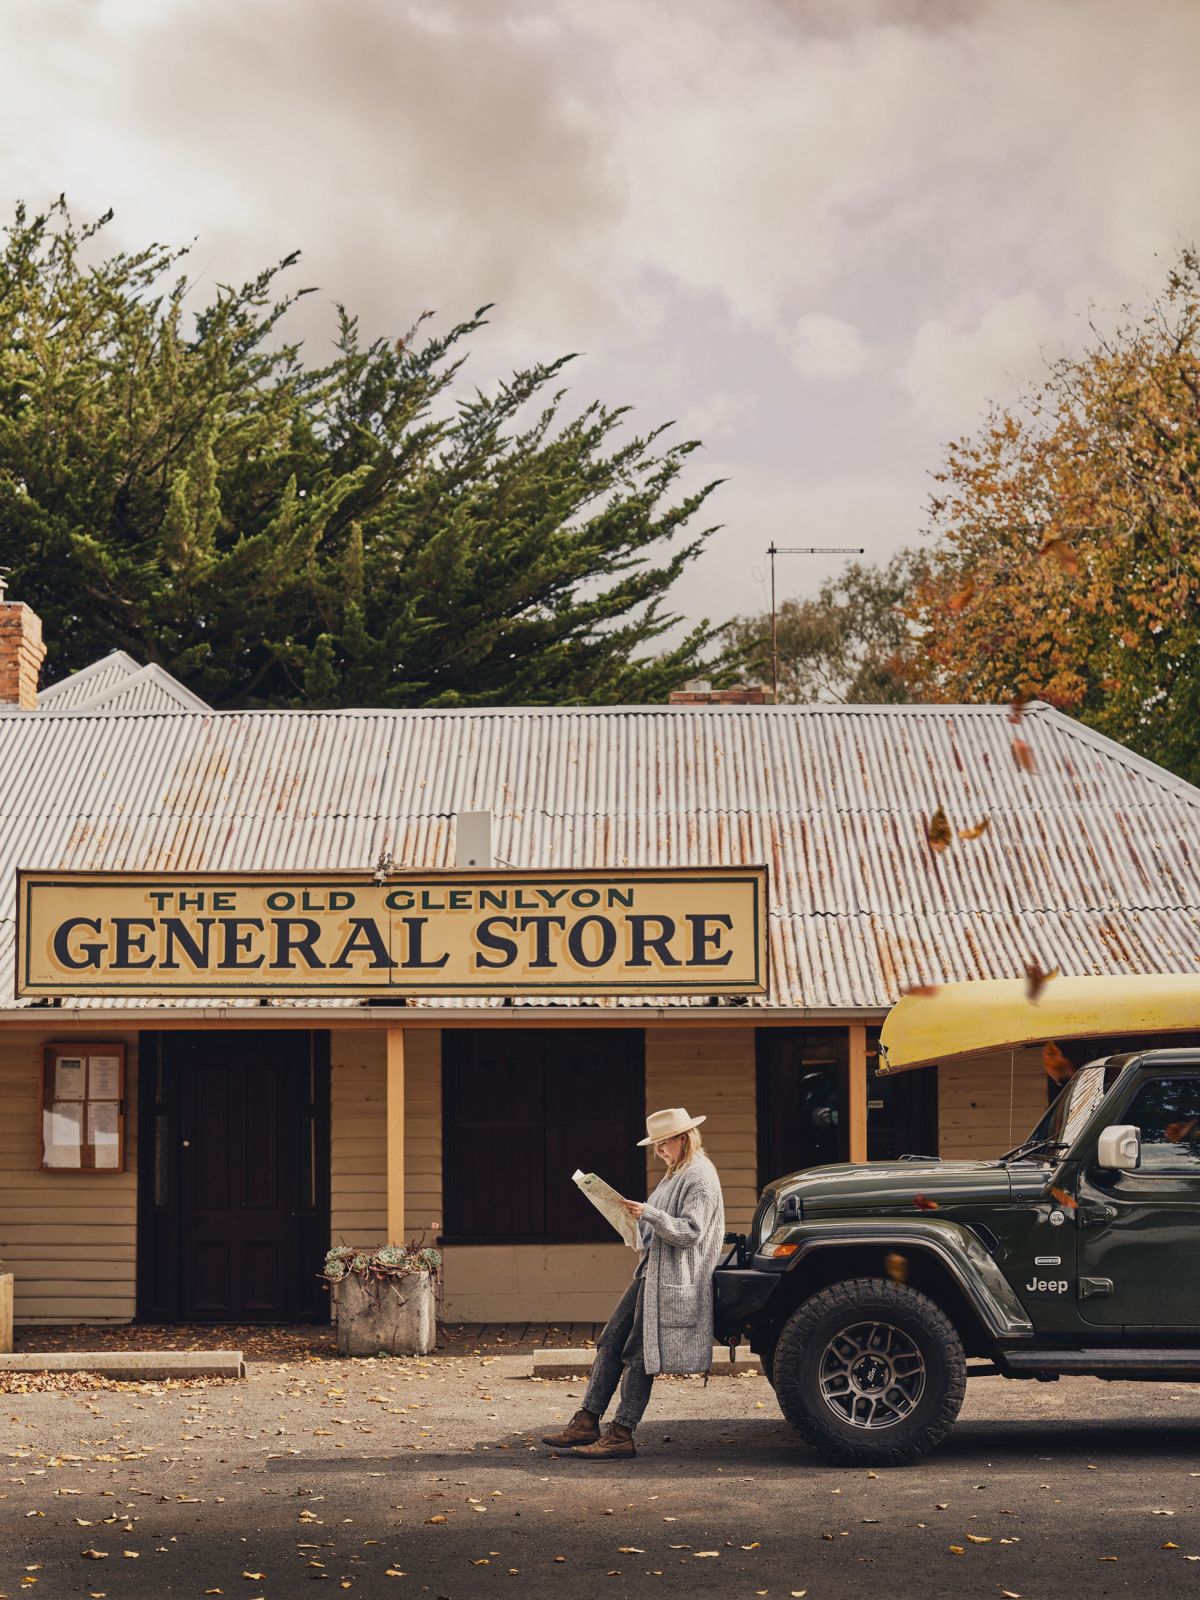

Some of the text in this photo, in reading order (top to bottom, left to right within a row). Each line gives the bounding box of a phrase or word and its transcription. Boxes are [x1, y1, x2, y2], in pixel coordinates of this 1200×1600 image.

[150, 888, 634, 910] THE OLD GLENLYON
[54, 915, 733, 969] GENERAL STORE
[1026, 1277, 1068, 1294] Jeep
